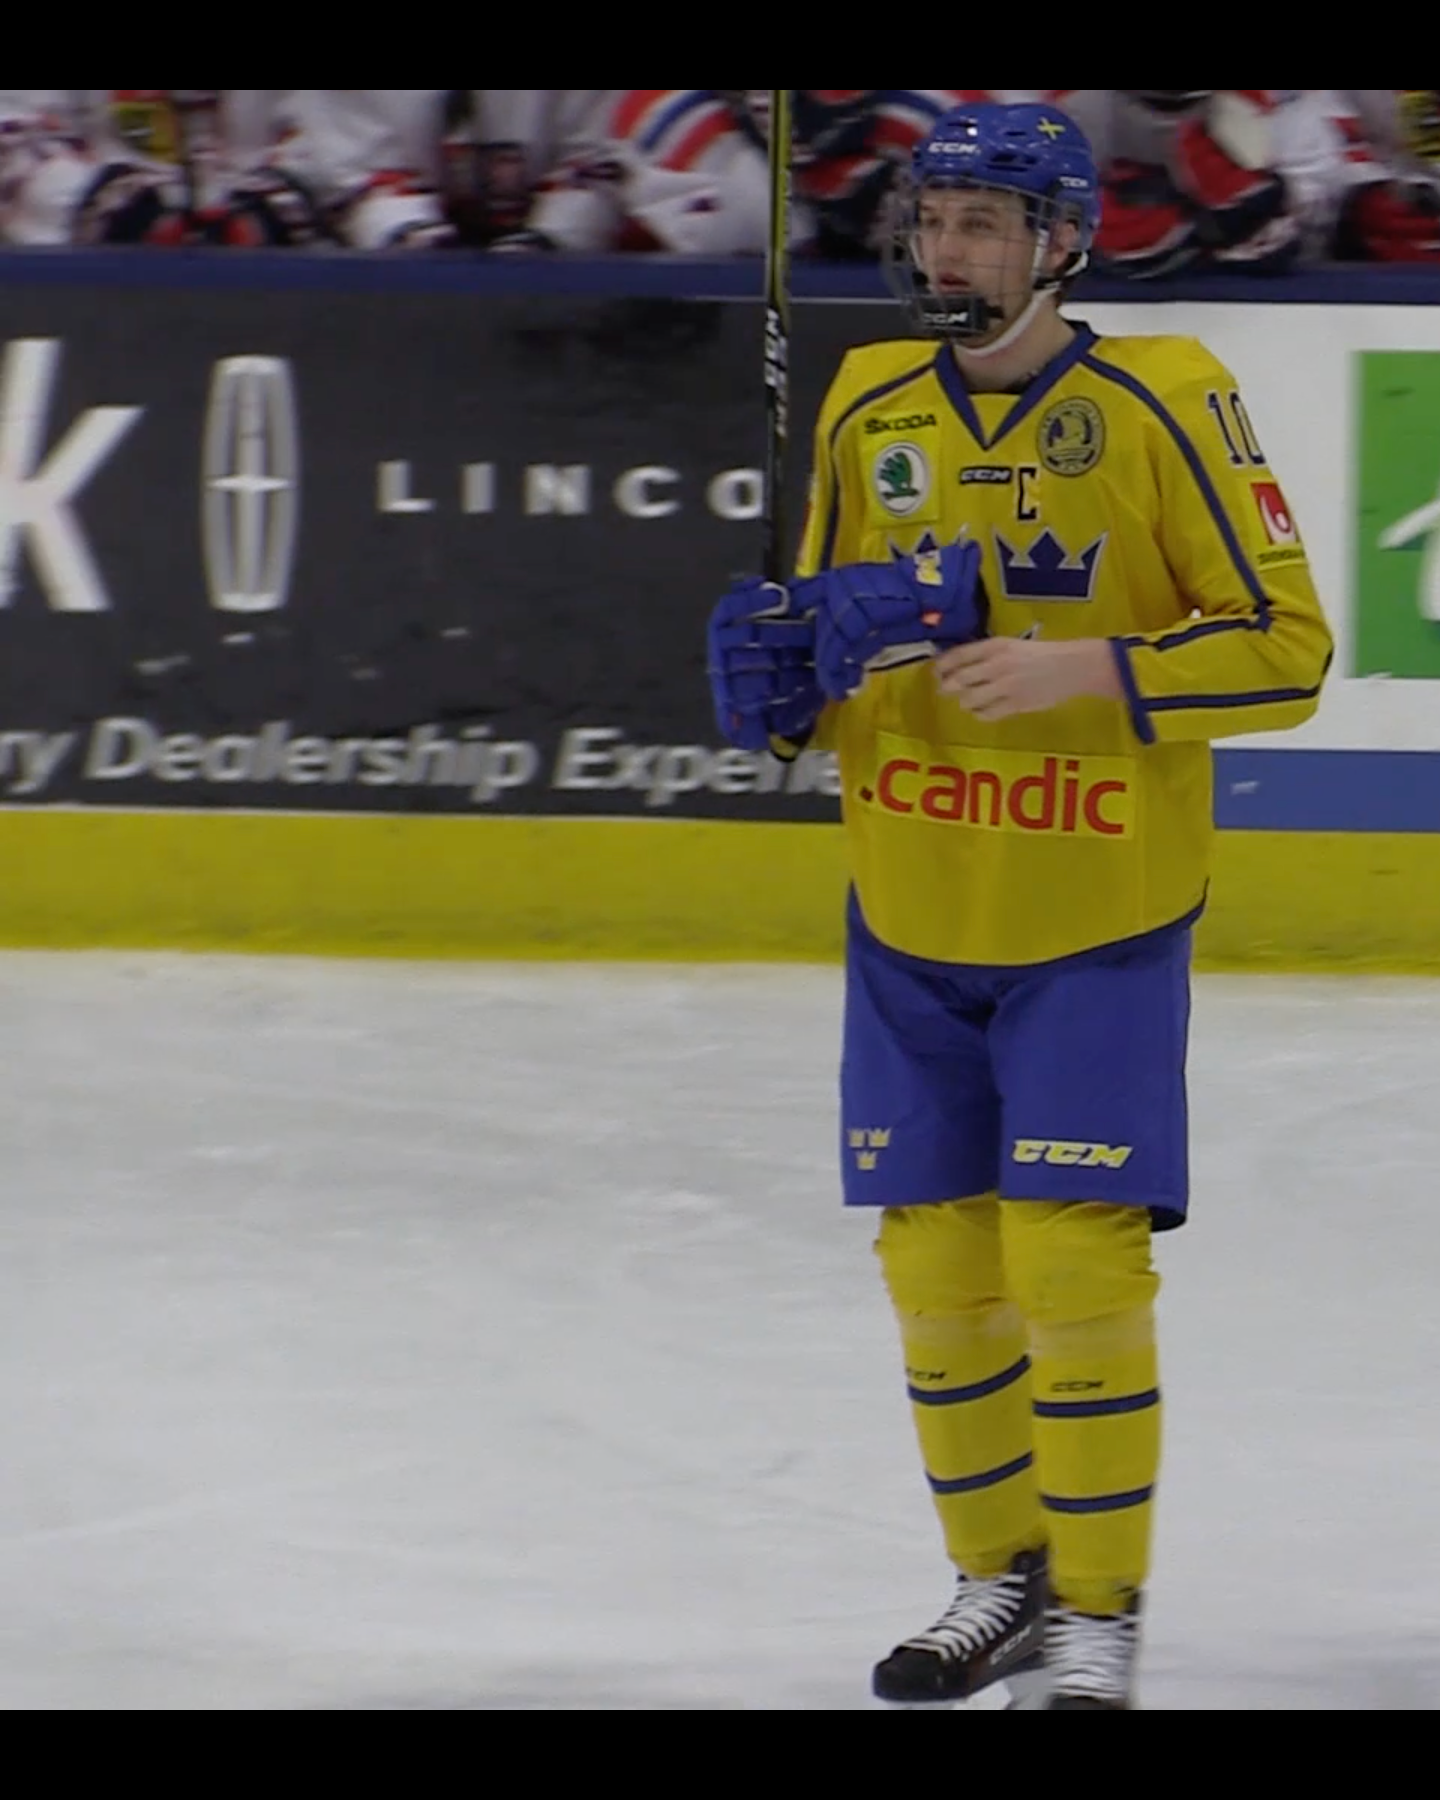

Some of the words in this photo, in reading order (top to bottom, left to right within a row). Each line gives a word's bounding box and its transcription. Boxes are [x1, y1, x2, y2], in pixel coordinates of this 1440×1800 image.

[1208, 391, 1266, 465] 10
[1018, 467, 1037, 520] C
[84, 717, 540, 803] Dealership
[858, 757, 1127, 834] candic
[1012, 1139, 1133, 1169] CCM
